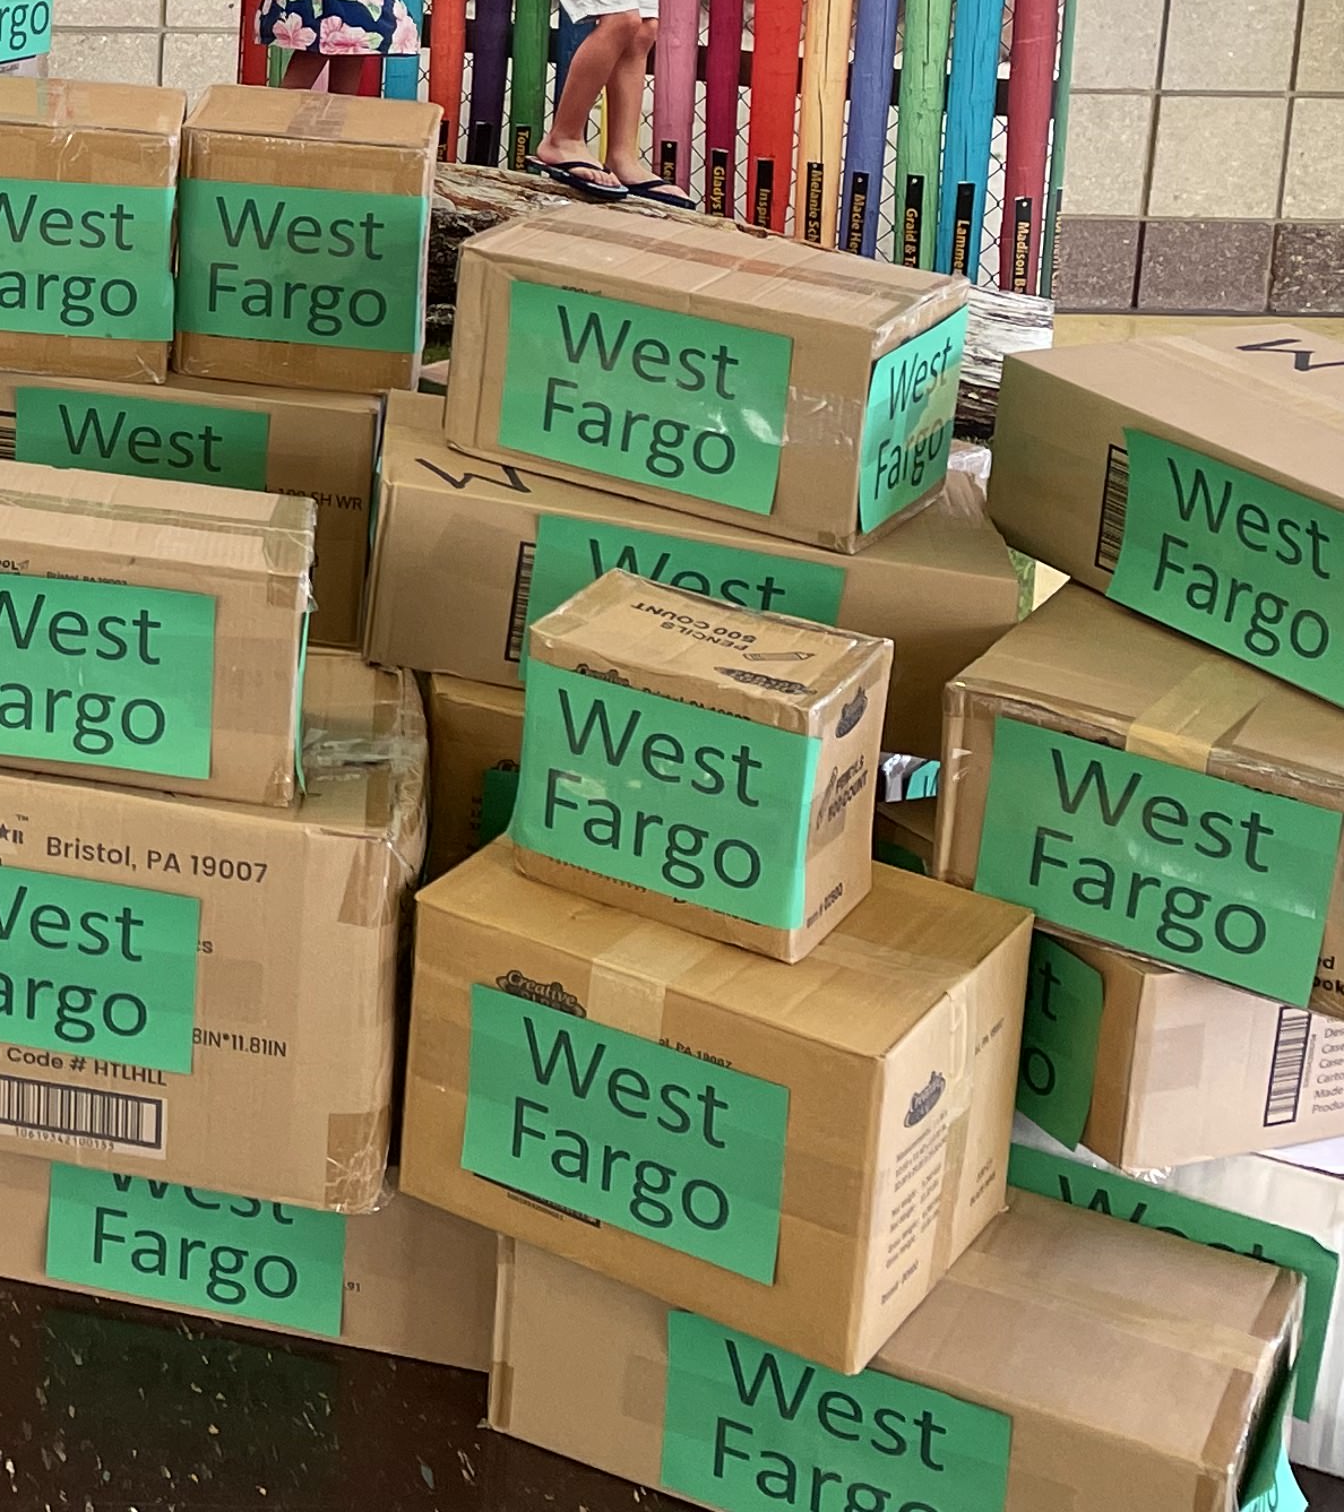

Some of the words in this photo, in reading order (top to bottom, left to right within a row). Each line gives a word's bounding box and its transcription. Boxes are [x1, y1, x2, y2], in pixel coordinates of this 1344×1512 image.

[216, 196, 383, 261] West
[207, 264, 387, 336] Fargo
[557, 305, 739, 400] West
[889, 338, 952, 420] West
[59, 404, 223, 473] West
[543, 378, 736, 478] Fargo
[875, 418, 942, 502] Fargo
[1166, 456, 1333, 579] West
[1153, 535, 1330, 662] Fargo
[559, 688, 762, 807] West
[45, 835, 138, 871] Bristol,
[146, 848, 182, 873] PA
[190, 854, 269, 885] 19007
[544, 769, 761, 890] Fargo
[1050, 747, 1273, 873] West
[1028, 828, 1267, 959] Fargo
[6, 1046, 64, 1071] Code
[93, 1059, 168, 1088] HTLHLL
[524, 1017, 726, 1148] West
[511, 1096, 730, 1231] Fargo
[92, 1207, 298, 1304] Fargo
[725, 1339, 947, 1472] West
